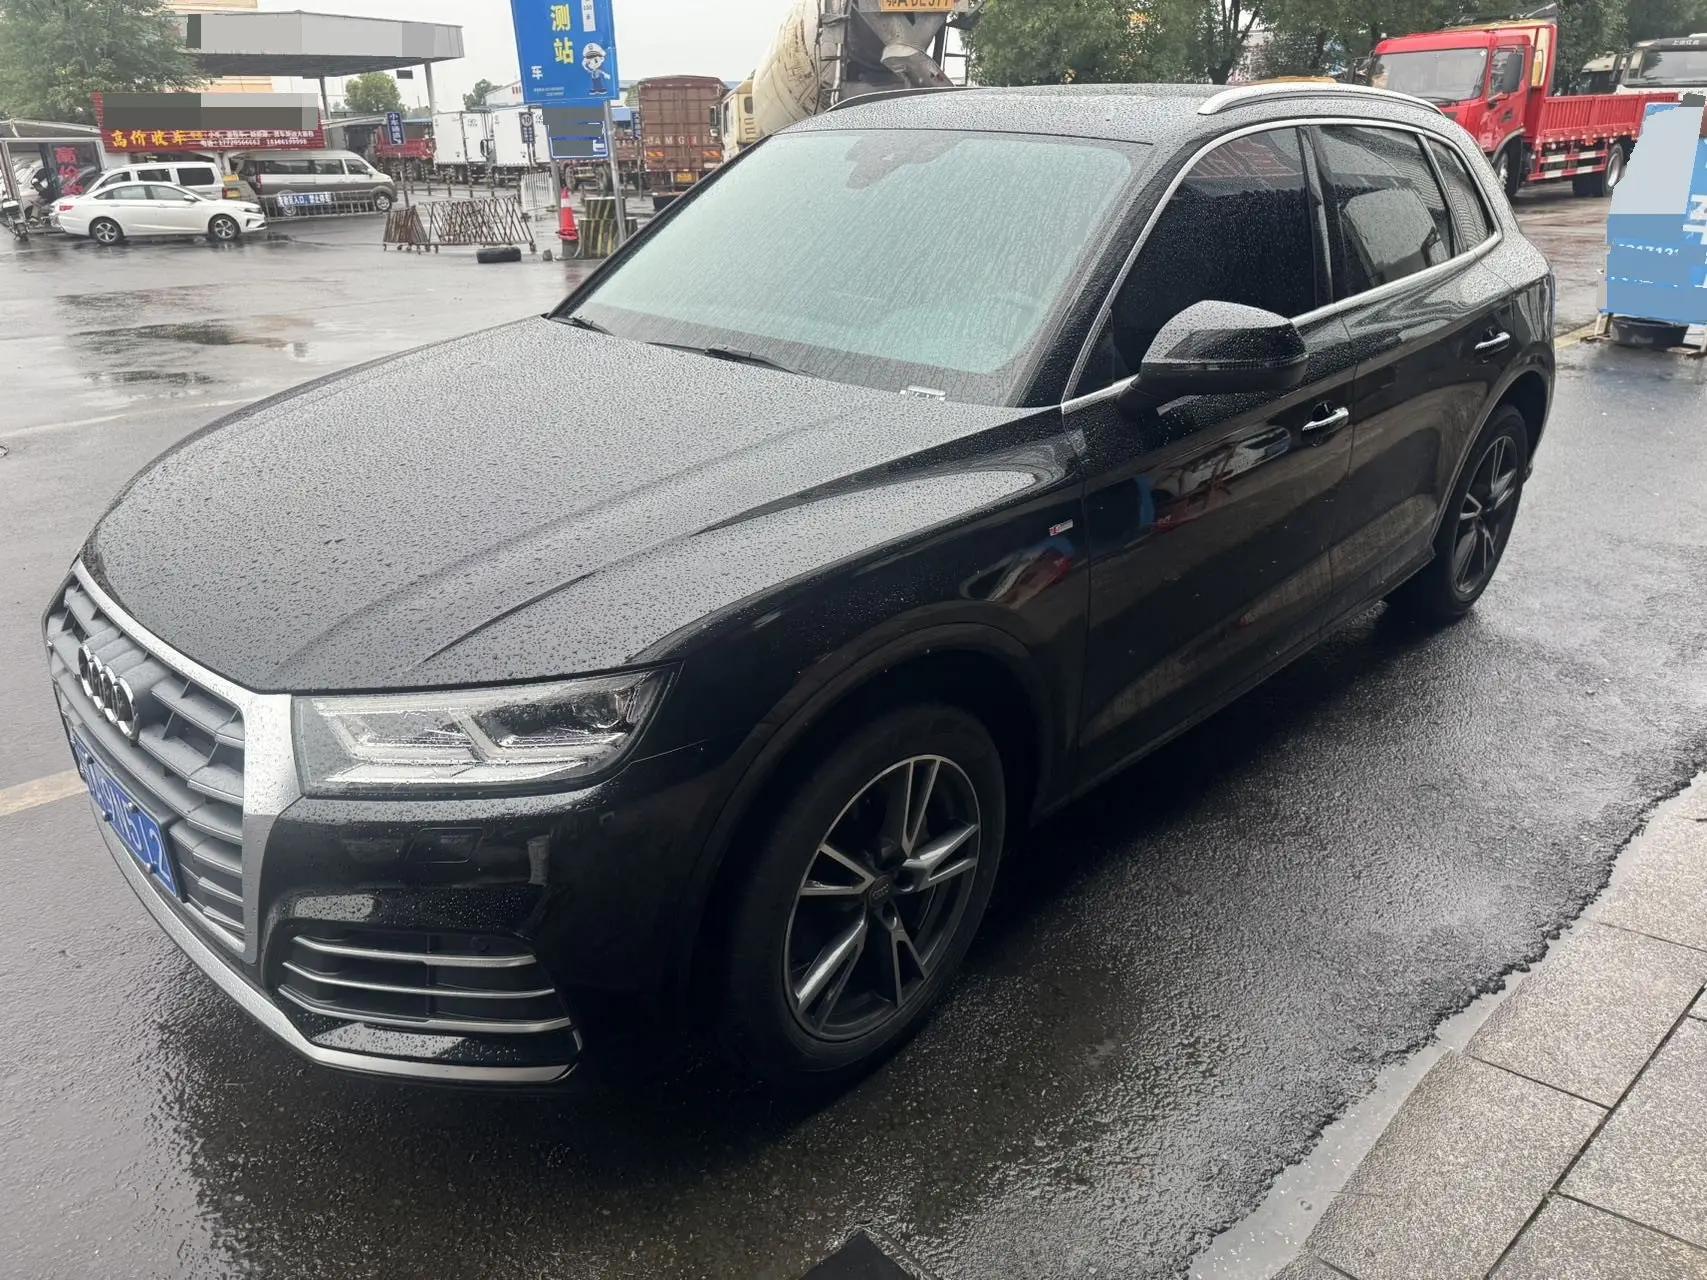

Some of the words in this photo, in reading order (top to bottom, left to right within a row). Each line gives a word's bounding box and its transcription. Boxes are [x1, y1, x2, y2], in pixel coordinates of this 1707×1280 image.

[550, 3, 574, 64] 测站
[111, 129, 187, 148] 高价收车
